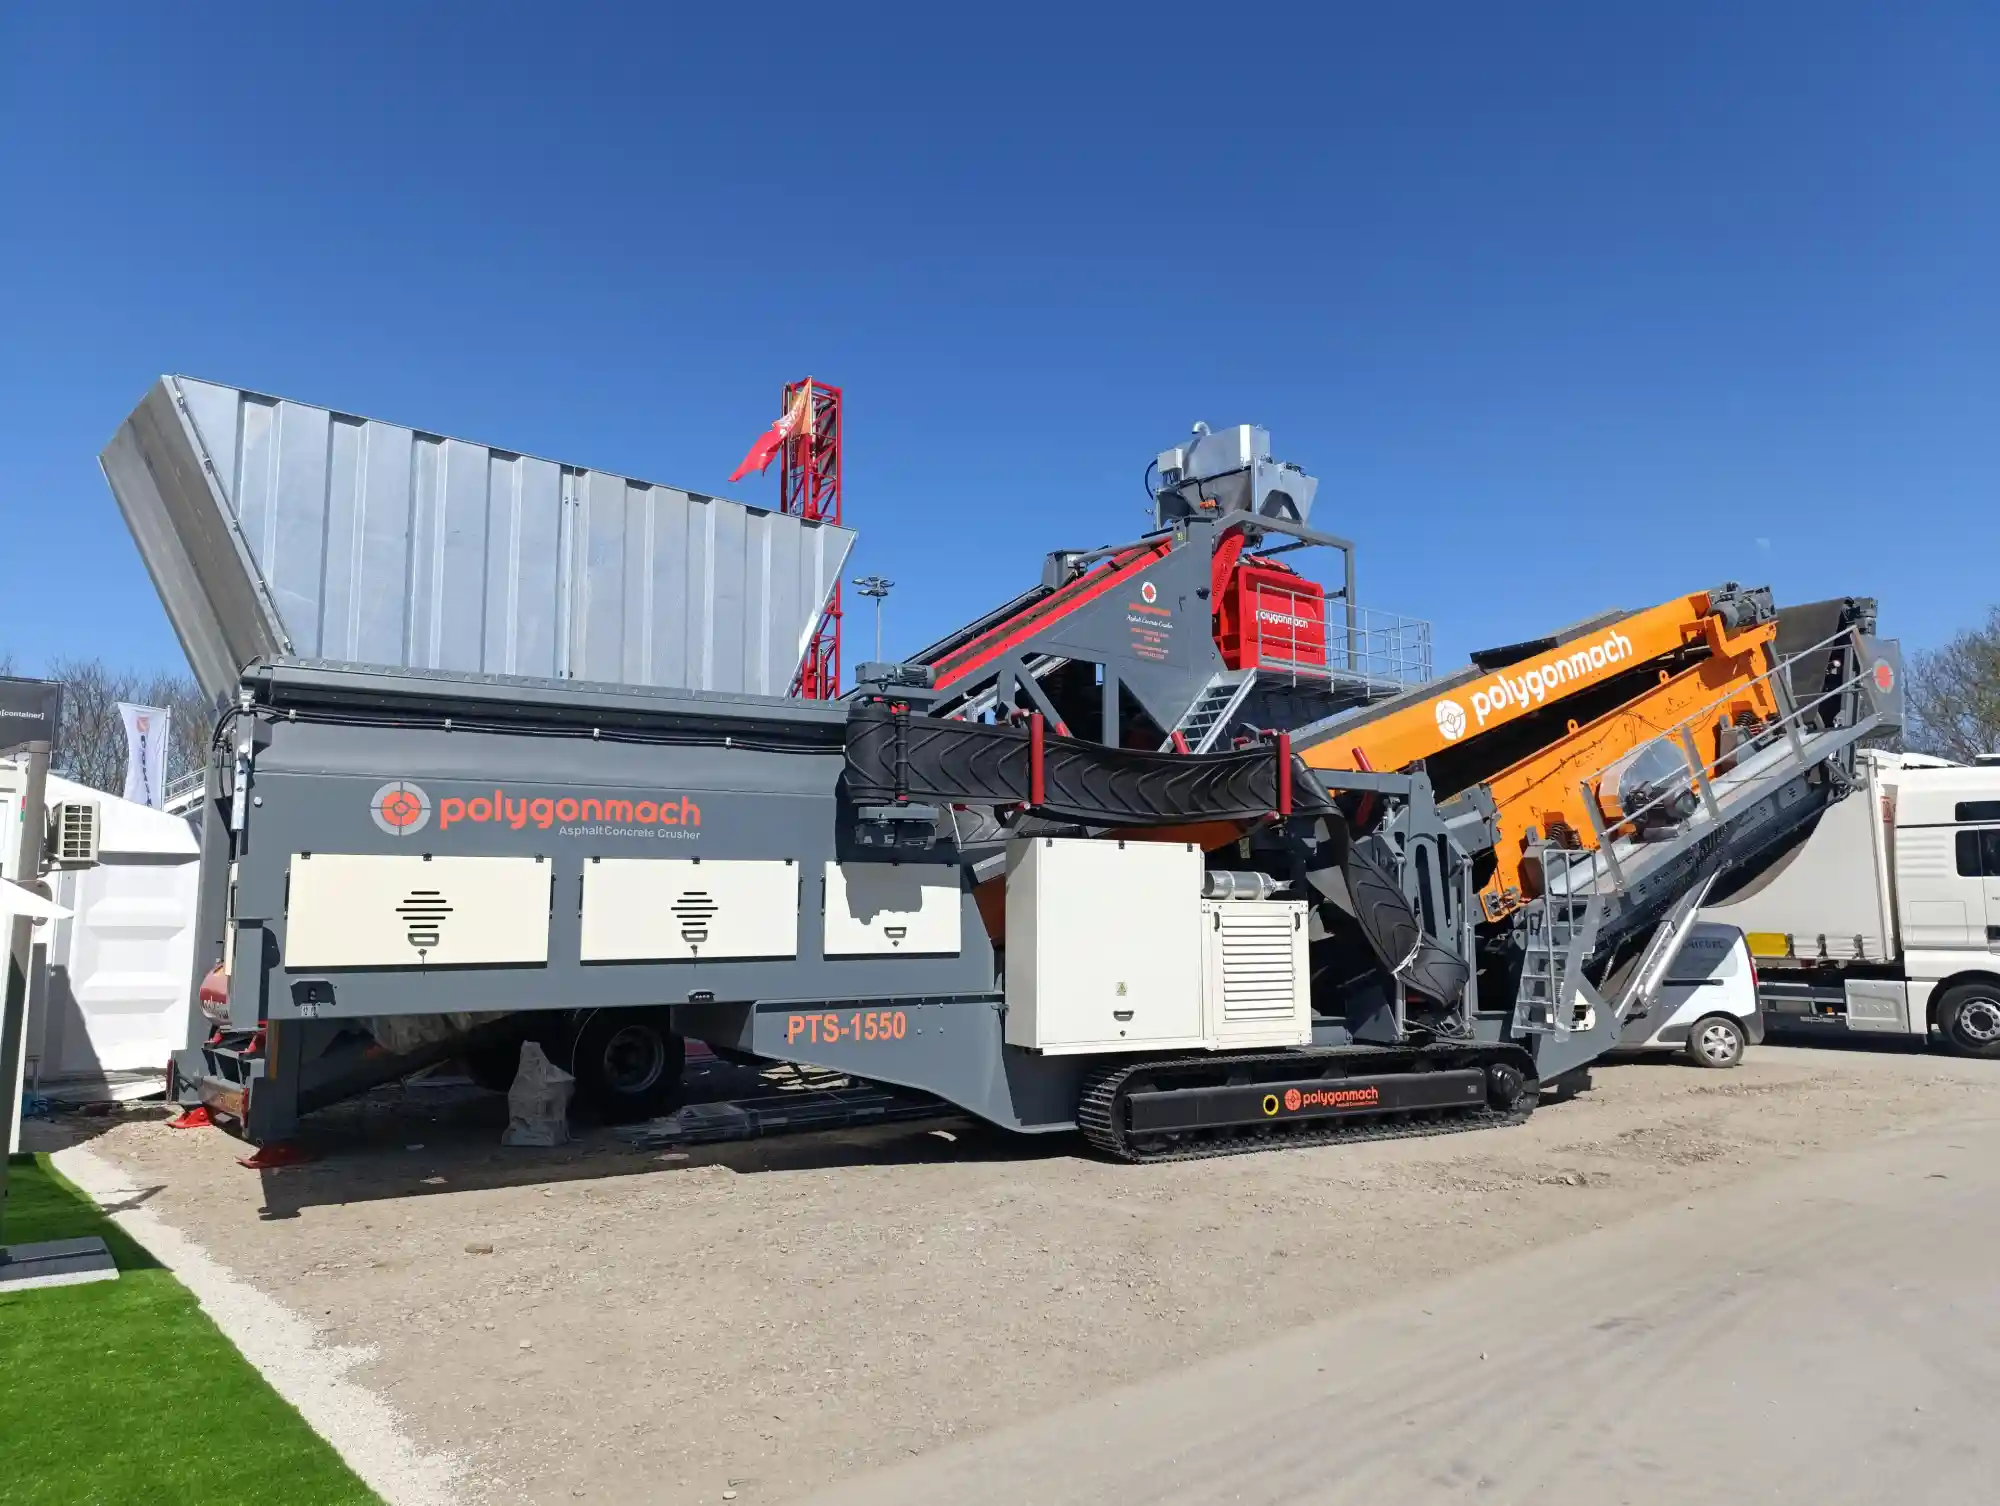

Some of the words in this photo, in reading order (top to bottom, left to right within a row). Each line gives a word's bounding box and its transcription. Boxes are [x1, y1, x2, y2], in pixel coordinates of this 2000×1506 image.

[1469, 630, 1633, 726] polygonmach
[0, 709, 45, 721] [container]
[439, 789, 701, 831] polygonmach
[558, 825, 603, 838] Asphalt
[604, 825, 655, 838] Concrete
[657, 828, 701, 840] Crusher
[787, 1011, 908, 1046] PTS-1550
[1303, 1085, 1379, 1108] polygonmach
